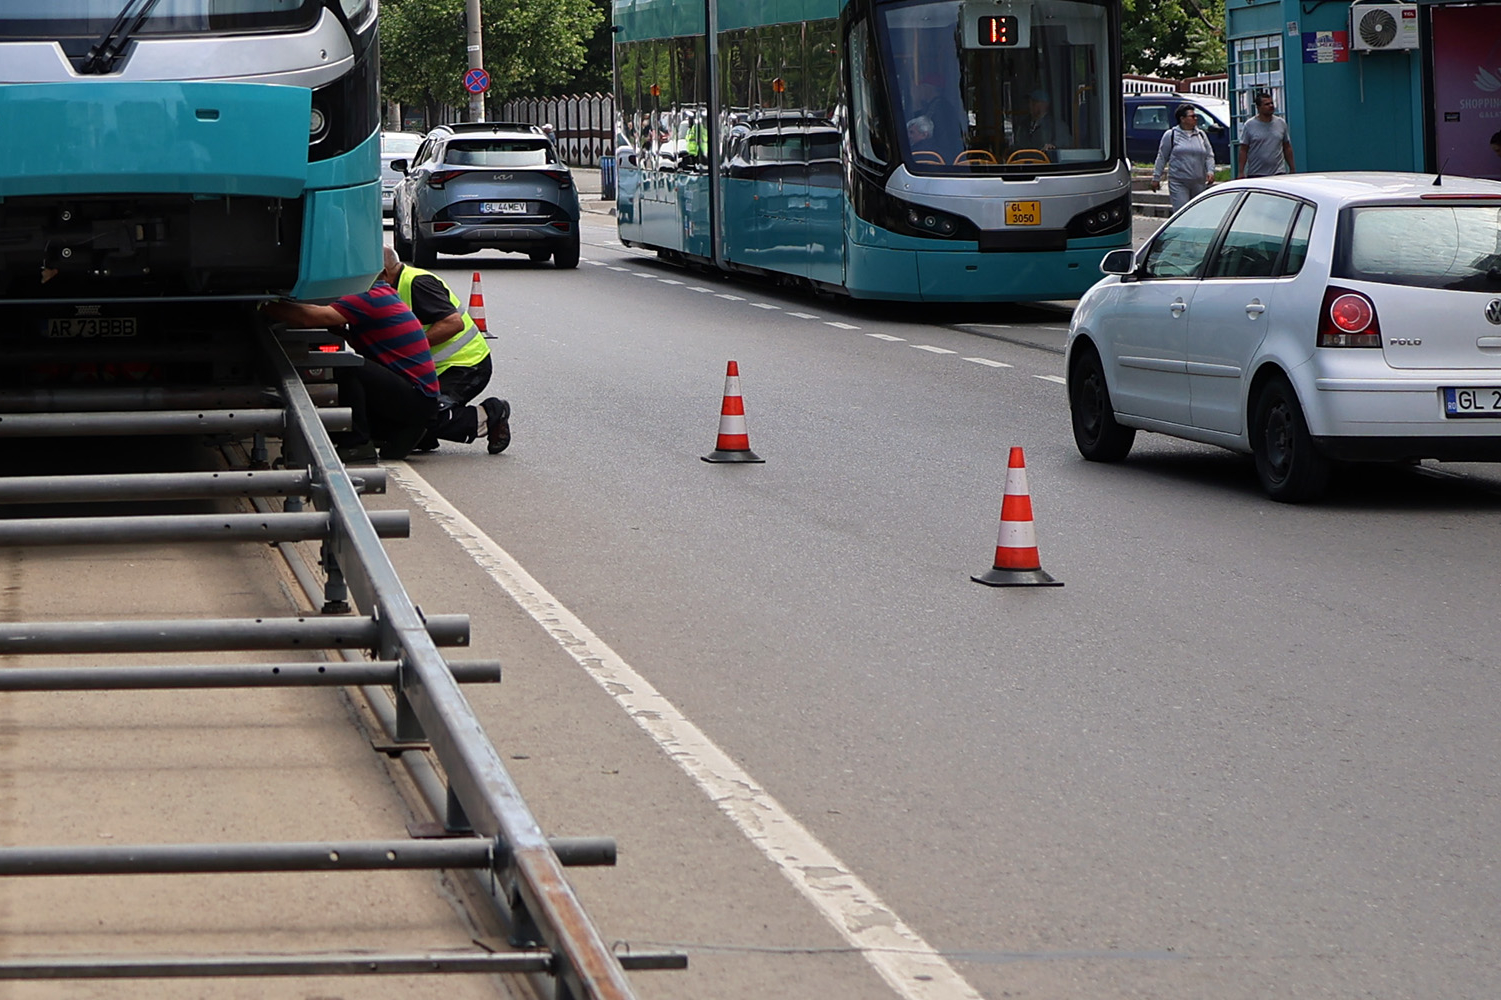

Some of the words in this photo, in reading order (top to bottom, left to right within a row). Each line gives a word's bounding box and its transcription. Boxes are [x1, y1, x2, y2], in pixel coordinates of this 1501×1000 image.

[484, 202, 496, 211] GL
[1011, 203, 1022, 212] GL
[1030, 202, 1036, 211] 1
[1012, 213, 1035, 223] 3050
[50, 320, 72, 337] AR
[1390, 337, 1422, 346] POLO
[1447, 401, 1457, 410] RO
[1458, 390, 1485, 410] GL
